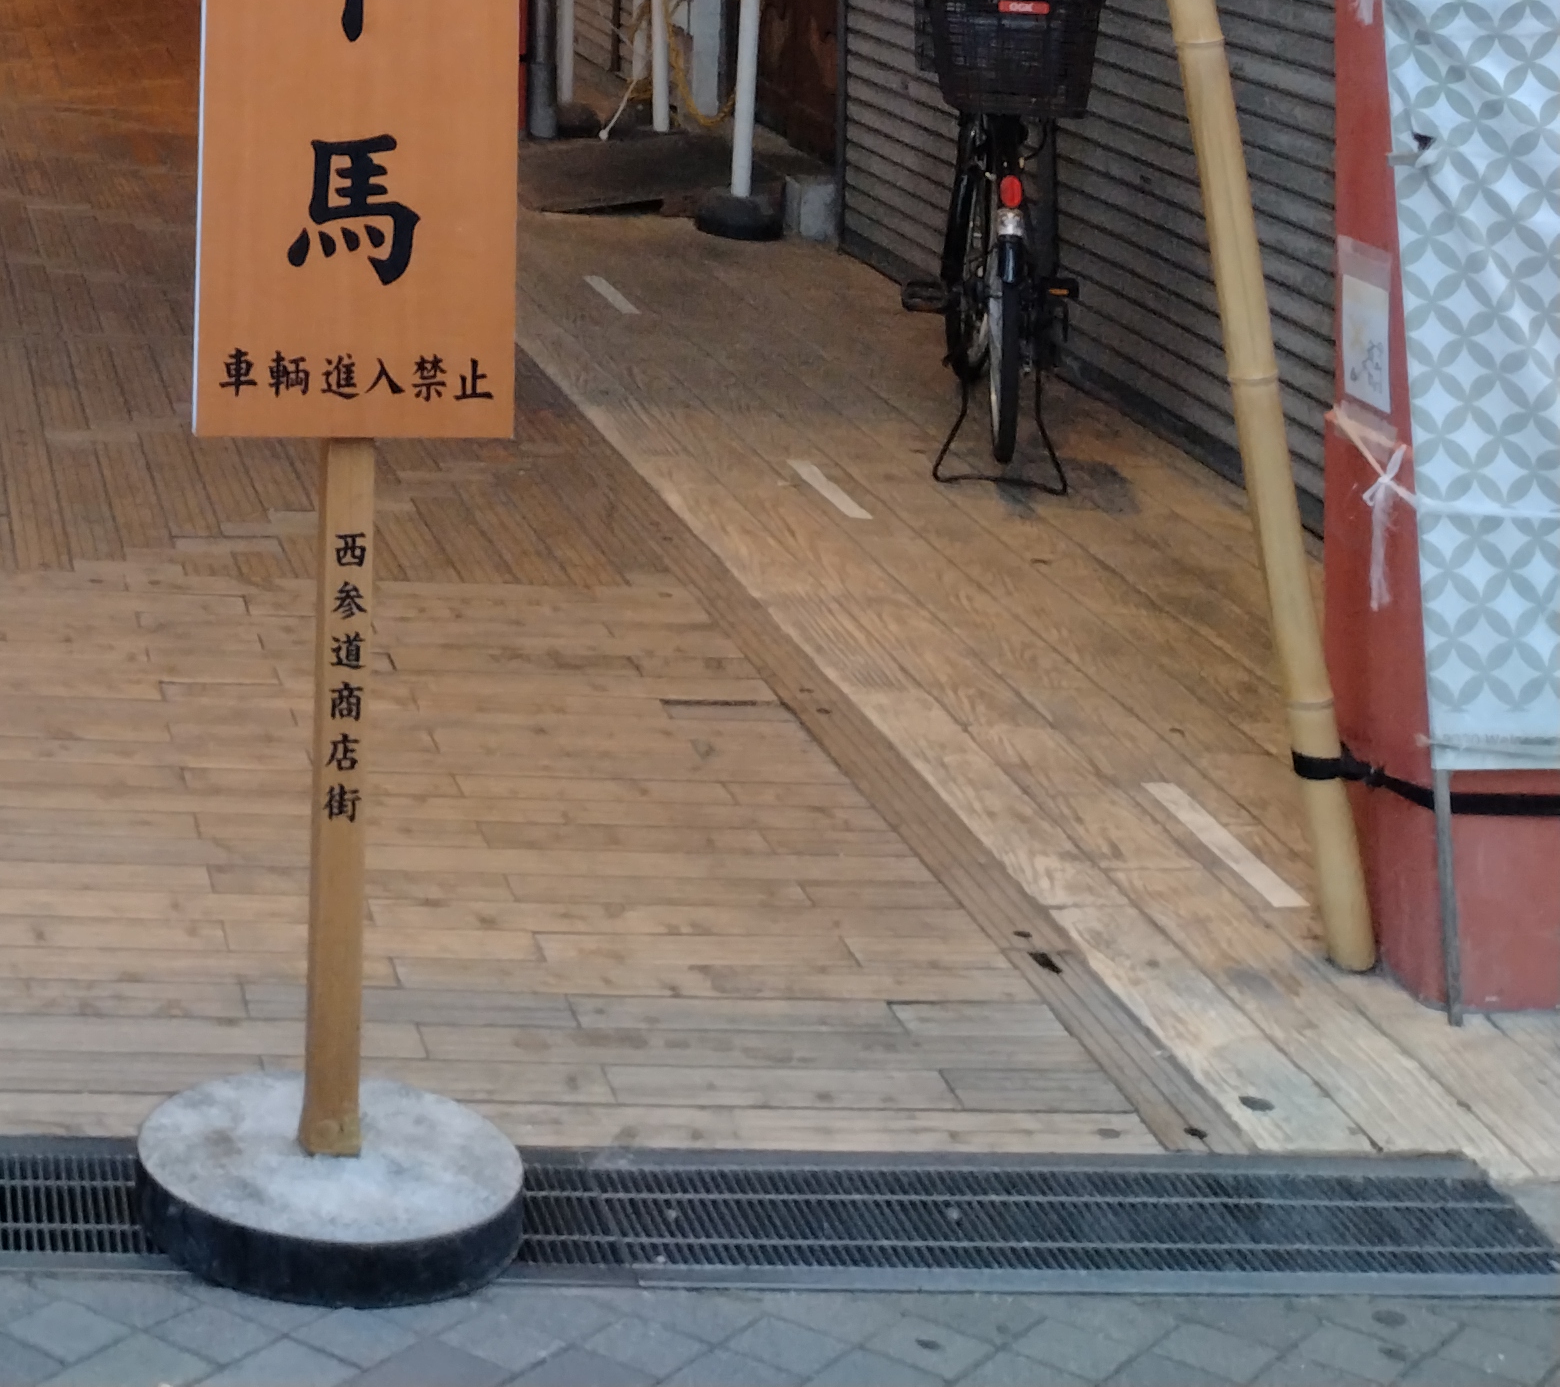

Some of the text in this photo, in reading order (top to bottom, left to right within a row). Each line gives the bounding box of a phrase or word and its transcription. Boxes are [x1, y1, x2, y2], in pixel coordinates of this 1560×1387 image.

[219, 347, 494, 402] 車輌進入禁止
[323, 532, 368, 824] 西参道商店街
